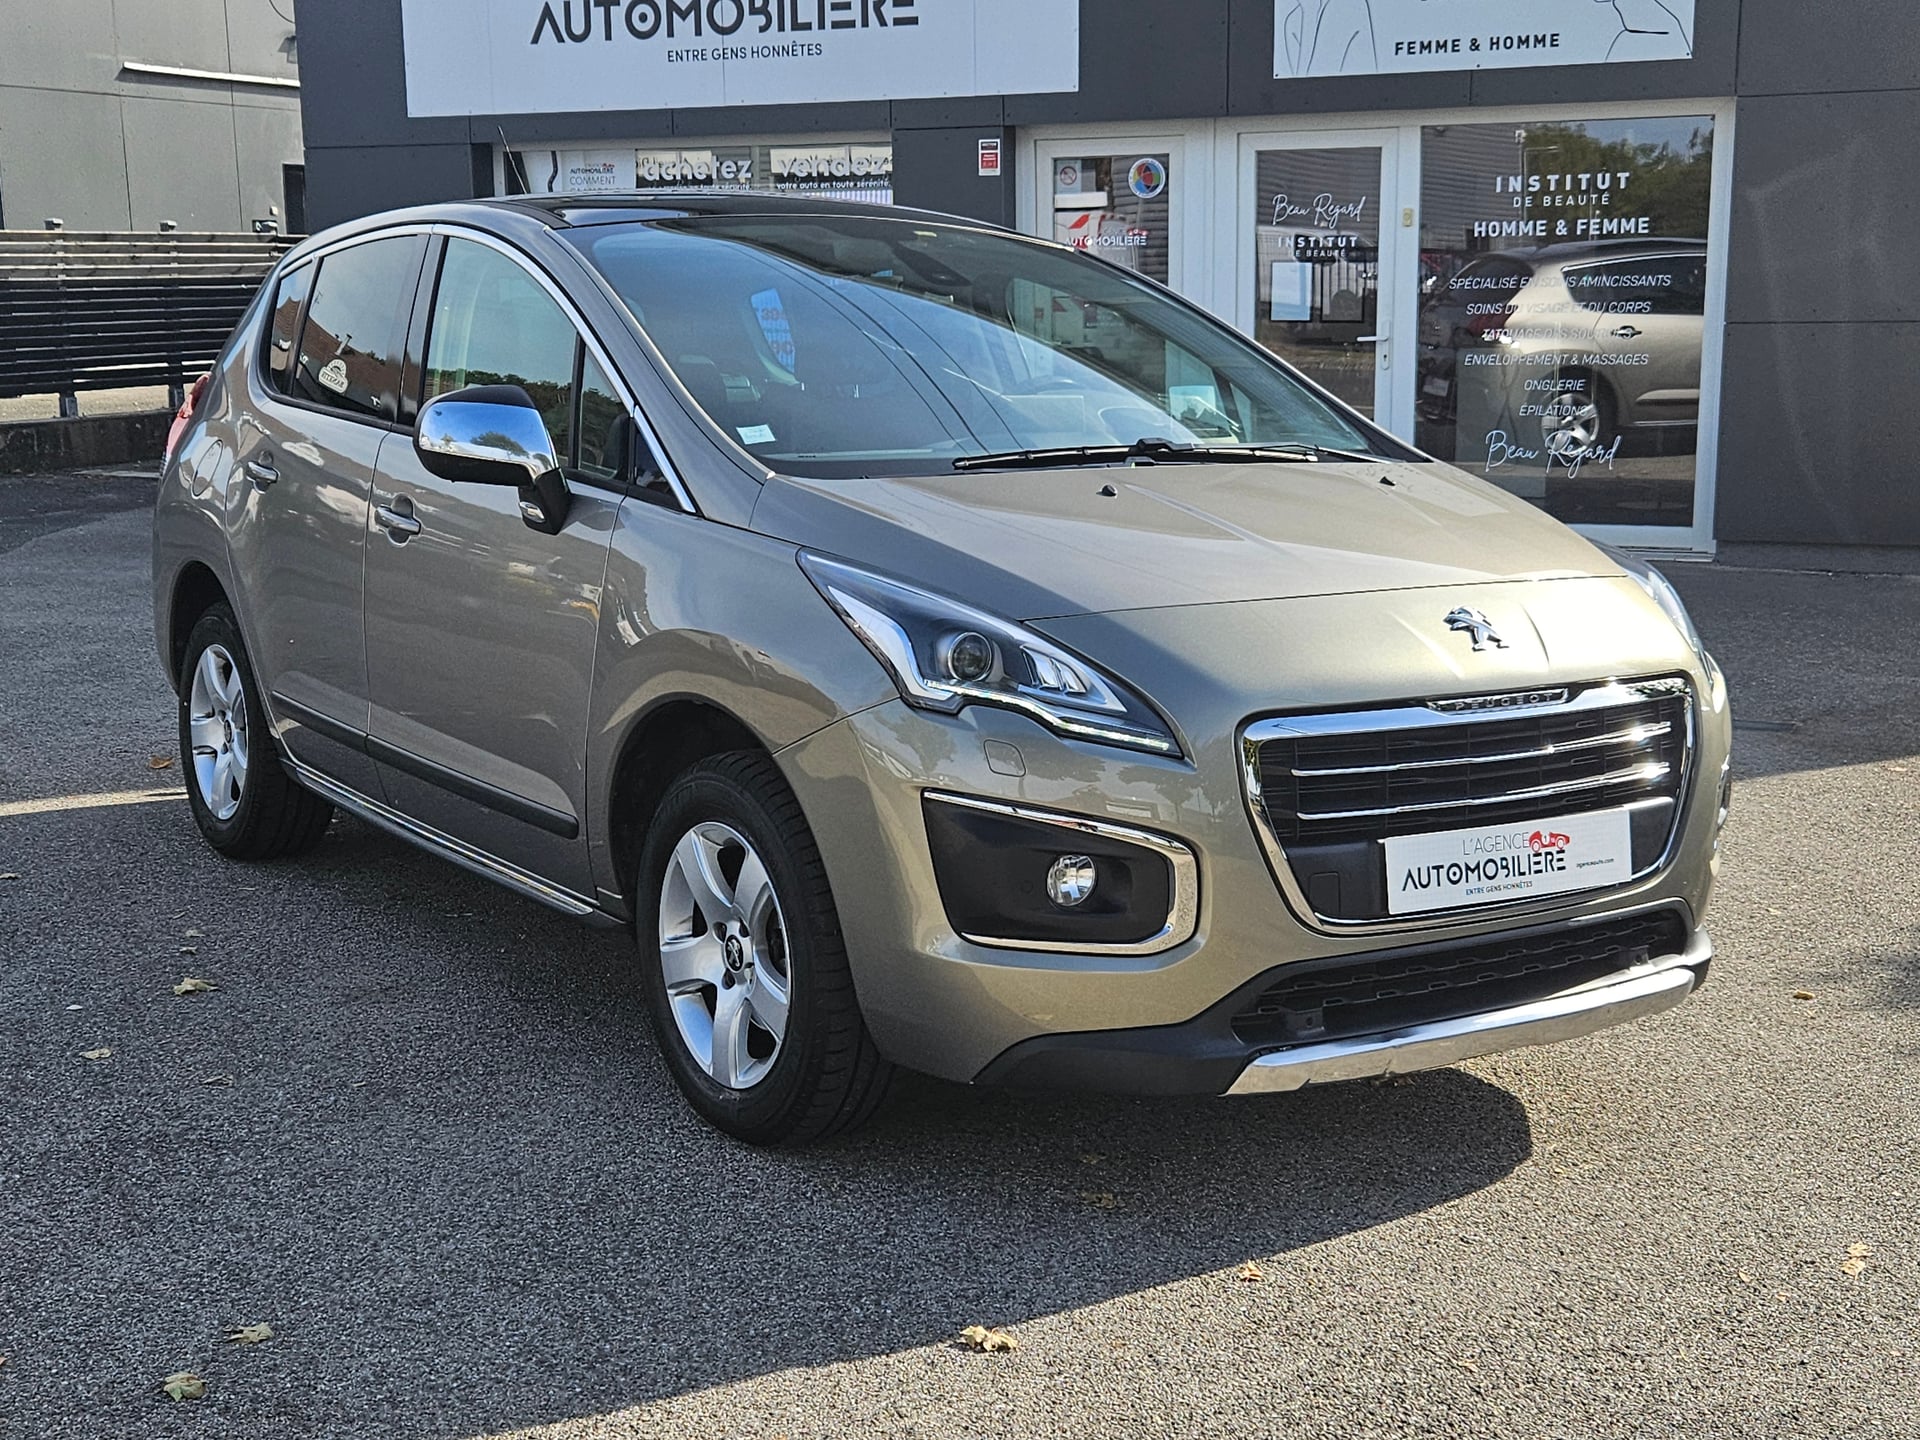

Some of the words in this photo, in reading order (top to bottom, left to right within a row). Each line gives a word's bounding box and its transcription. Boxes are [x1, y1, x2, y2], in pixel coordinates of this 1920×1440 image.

[667, 47, 707, 63] ENTRE
[711, 46, 747, 60] GENS
[751, 40, 823, 59] HONNÊTES
[1395, 38, 1461, 55] FEMME
[1469, 37, 1481, 52] &
[1489, 33, 1560, 50] HOMME
[643, 154, 752, 181] achetez
[778, 145, 886, 178] vendez
[570, 175, 616, 186] COMMENT
[776, 181, 797, 190] votre
[800, 181, 818, 190] auto
[833, 180, 854, 189] toute
[1495, 172, 1630, 193] INSTITUT
[1513, 196, 1533, 208] DE
[1543, 192, 1610, 207] BEAUTÉ
[1272, 193, 1310, 226] Beau
[1313, 192, 1366, 230] Regard
[1473, 219, 1548, 238] HOMME
[1555, 219, 1568, 236] &
[1576, 217, 1650, 235] FEMME
[1278, 236, 1358, 248] INSTITUT
[1449, 275, 1517, 290] SPÉCIALISÉ
[1578, 275, 1672, 287] AMINCISSANTS
[1466, 303, 1502, 315] SOINS
[1589, 302, 1606, 313] DU
[1609, 301, 1652, 313] CORPS
[1464, 354, 1569, 366] ENVELOPPEMENT
[1570, 353, 1578, 365] &
[1582, 353, 1649, 365] MASSAGES
[1524, 379, 1587, 391] ONGLERIE
[1485, 430, 1539, 473] Beau
[1544, 429, 1623, 479] Regard
[1455, 692, 1553, 711] PEUGEOT
[1462, 831, 1530, 856] L'AGENCE
[1466, 886, 1485, 896] ENTRE
[1486, 884, 1501, 893] GENS
[1503, 881, 1533, 891] HONNÊTES
